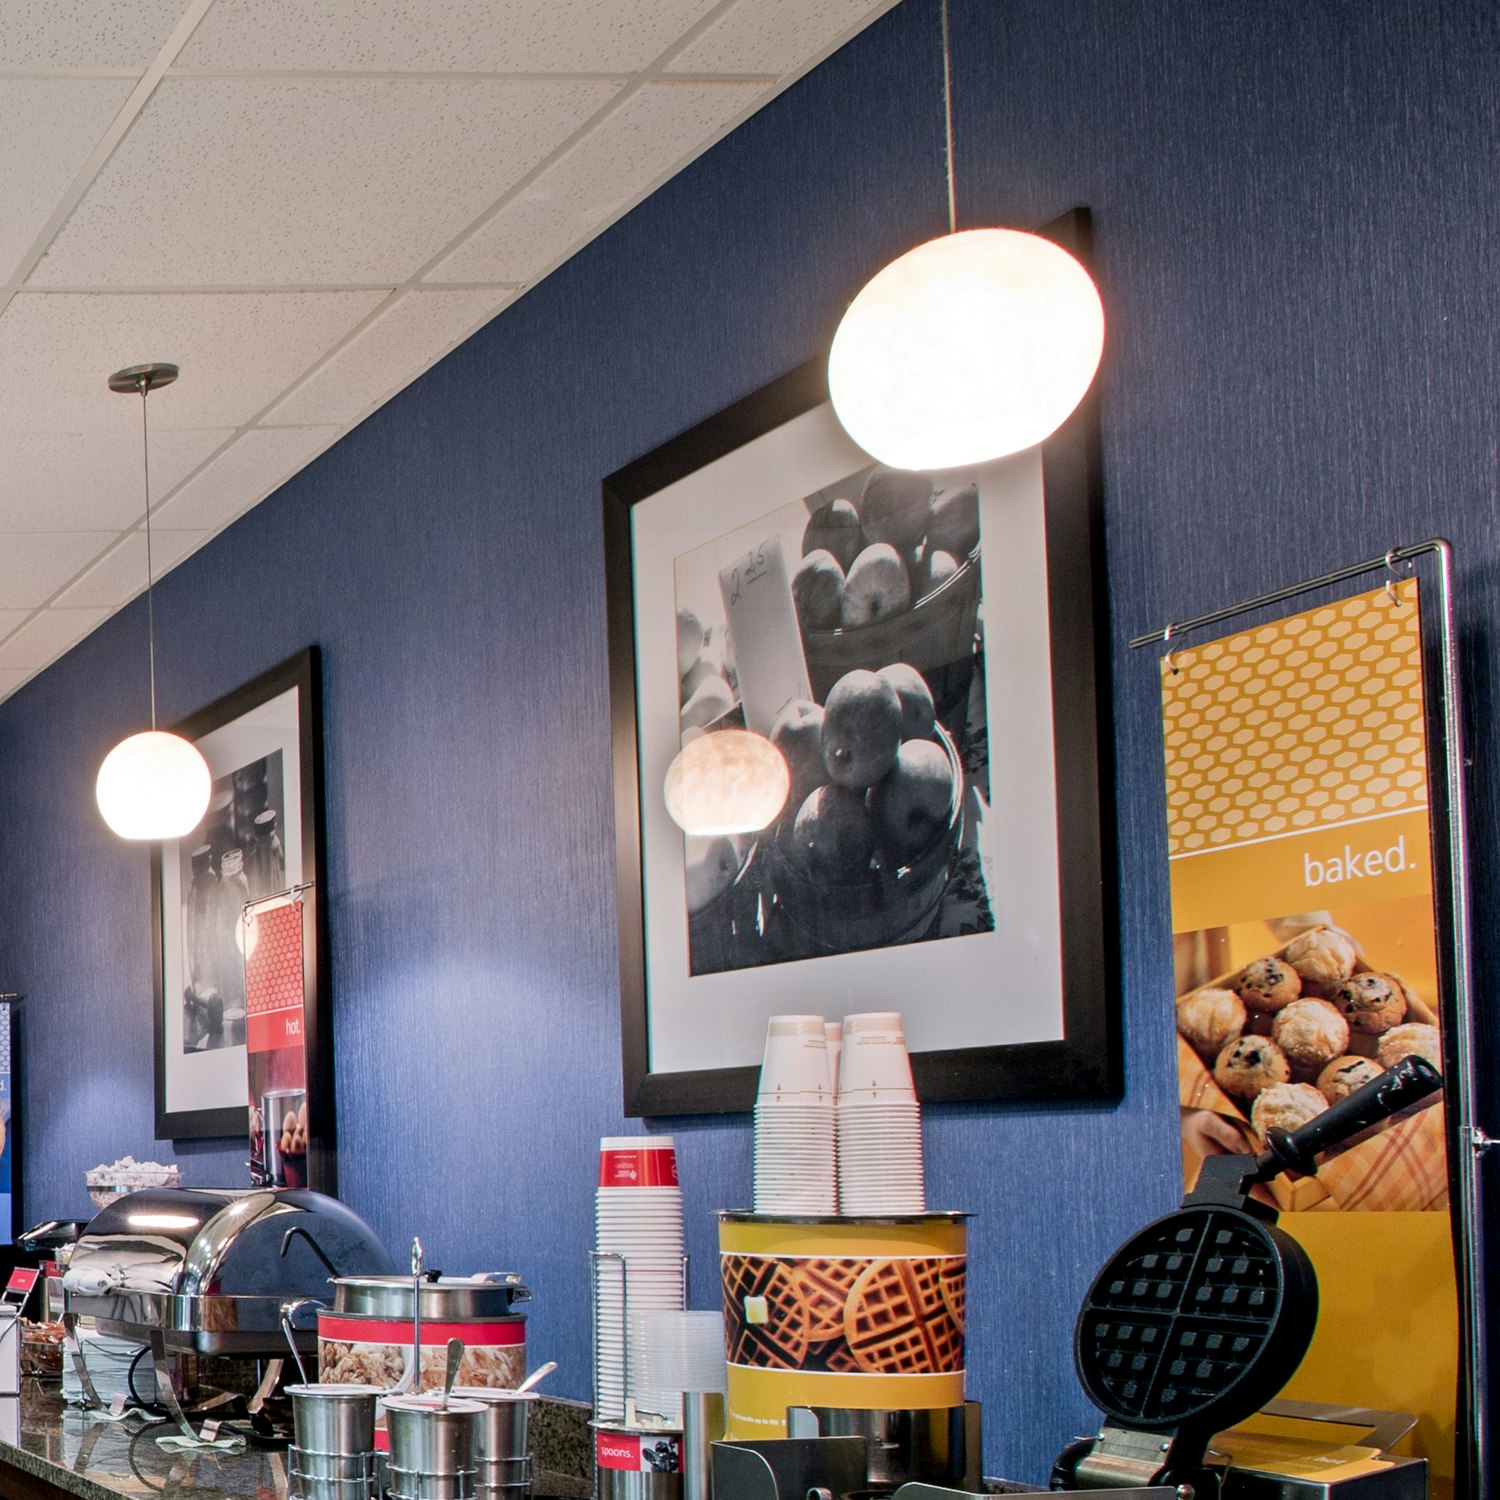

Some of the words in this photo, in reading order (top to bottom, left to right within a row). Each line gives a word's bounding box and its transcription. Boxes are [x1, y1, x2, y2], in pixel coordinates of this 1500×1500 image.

[1304, 834, 1416, 887] baked.
[285, 1018, 301, 1035] hot.
[601, 1446, 634, 1459] spoons.
